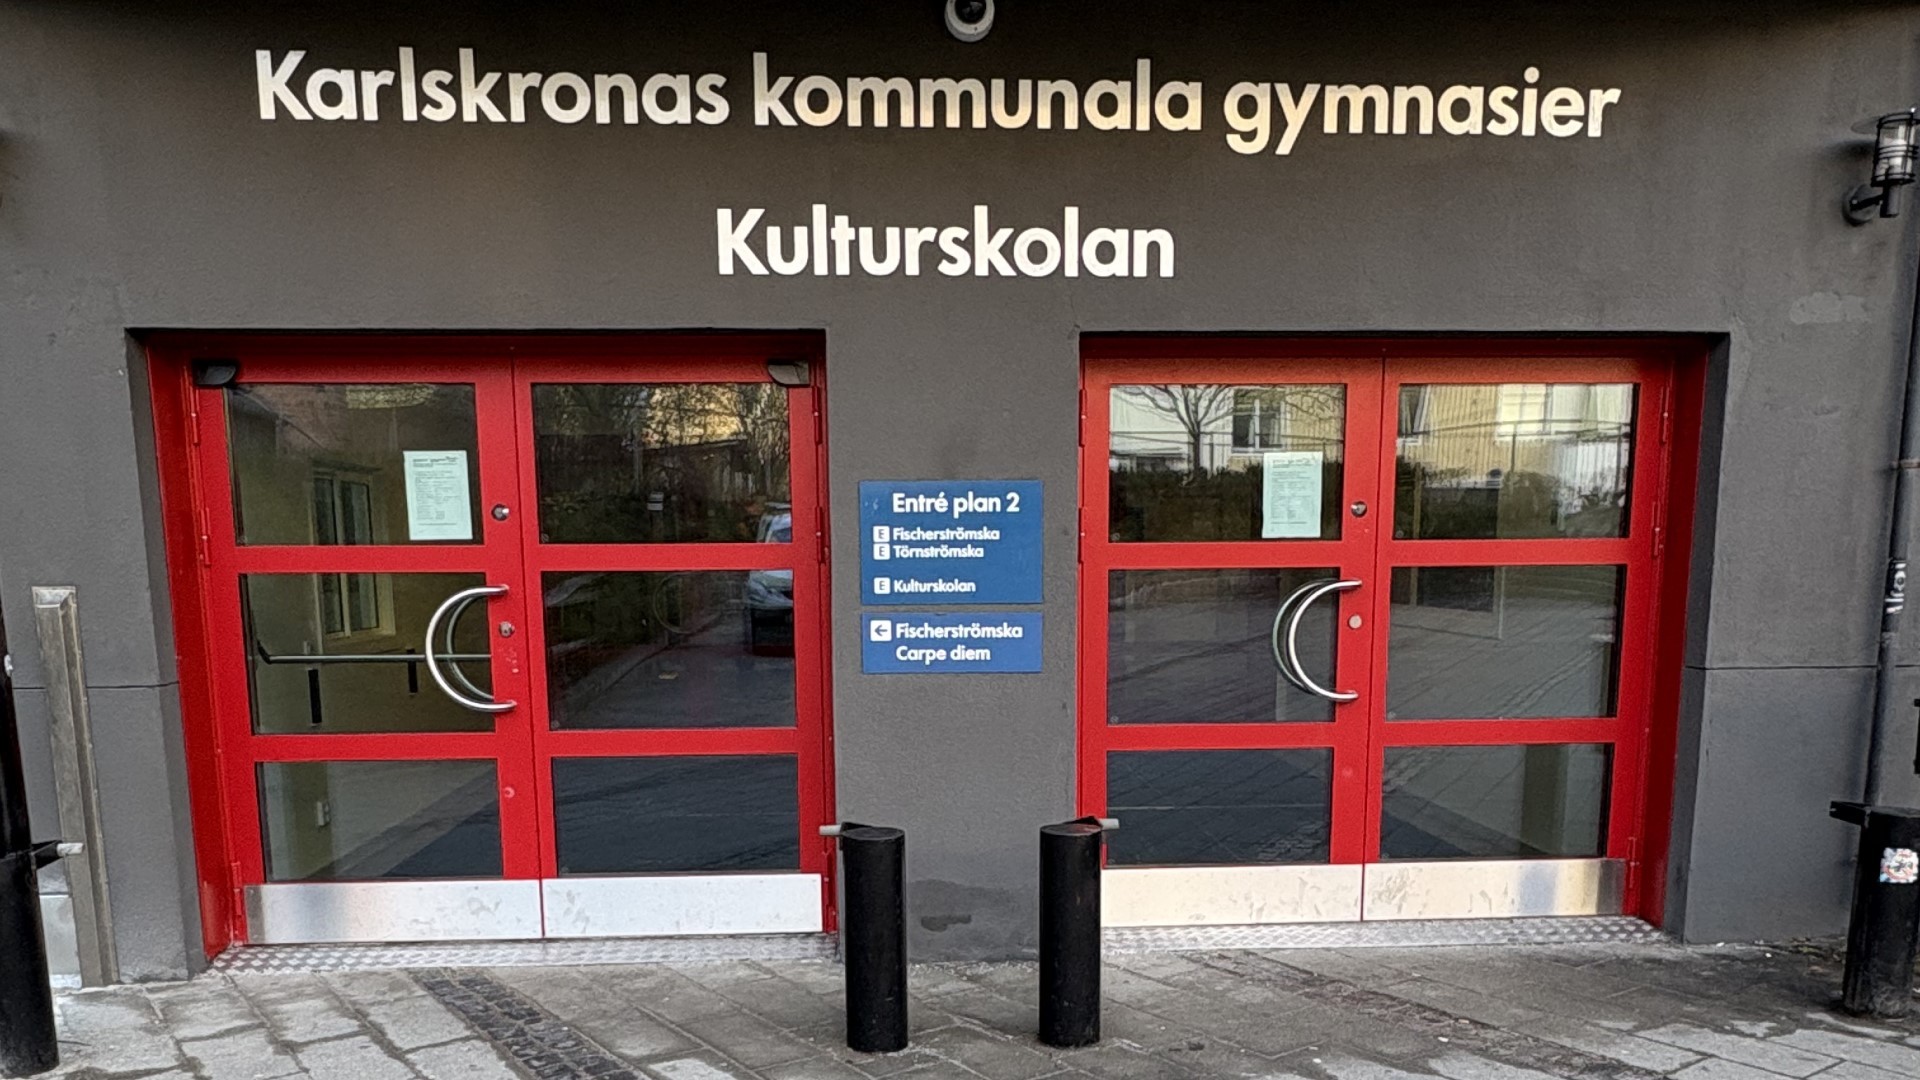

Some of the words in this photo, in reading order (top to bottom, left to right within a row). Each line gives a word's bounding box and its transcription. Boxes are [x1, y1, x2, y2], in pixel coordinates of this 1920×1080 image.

[256, 47, 730, 125] Karlskronas
[753, 52, 1203, 132] kommunala
[1224, 66, 1622, 155] gymnasier
[716, 203, 1175, 279] Kulturskolan
[892, 491, 949, 513] Entré
[953, 491, 1001, 519] plan
[1006, 492, 1020, 513] 2
[893, 526, 1001, 541] Fischerströmska
[893, 545, 985, 559] Törnströmska
[893, 578, 976, 593] Kulturskolan
[896, 622, 1023, 639] Fischerströmska
[896, 645, 947, 665] Carpe
[950, 644, 991, 661] diem
